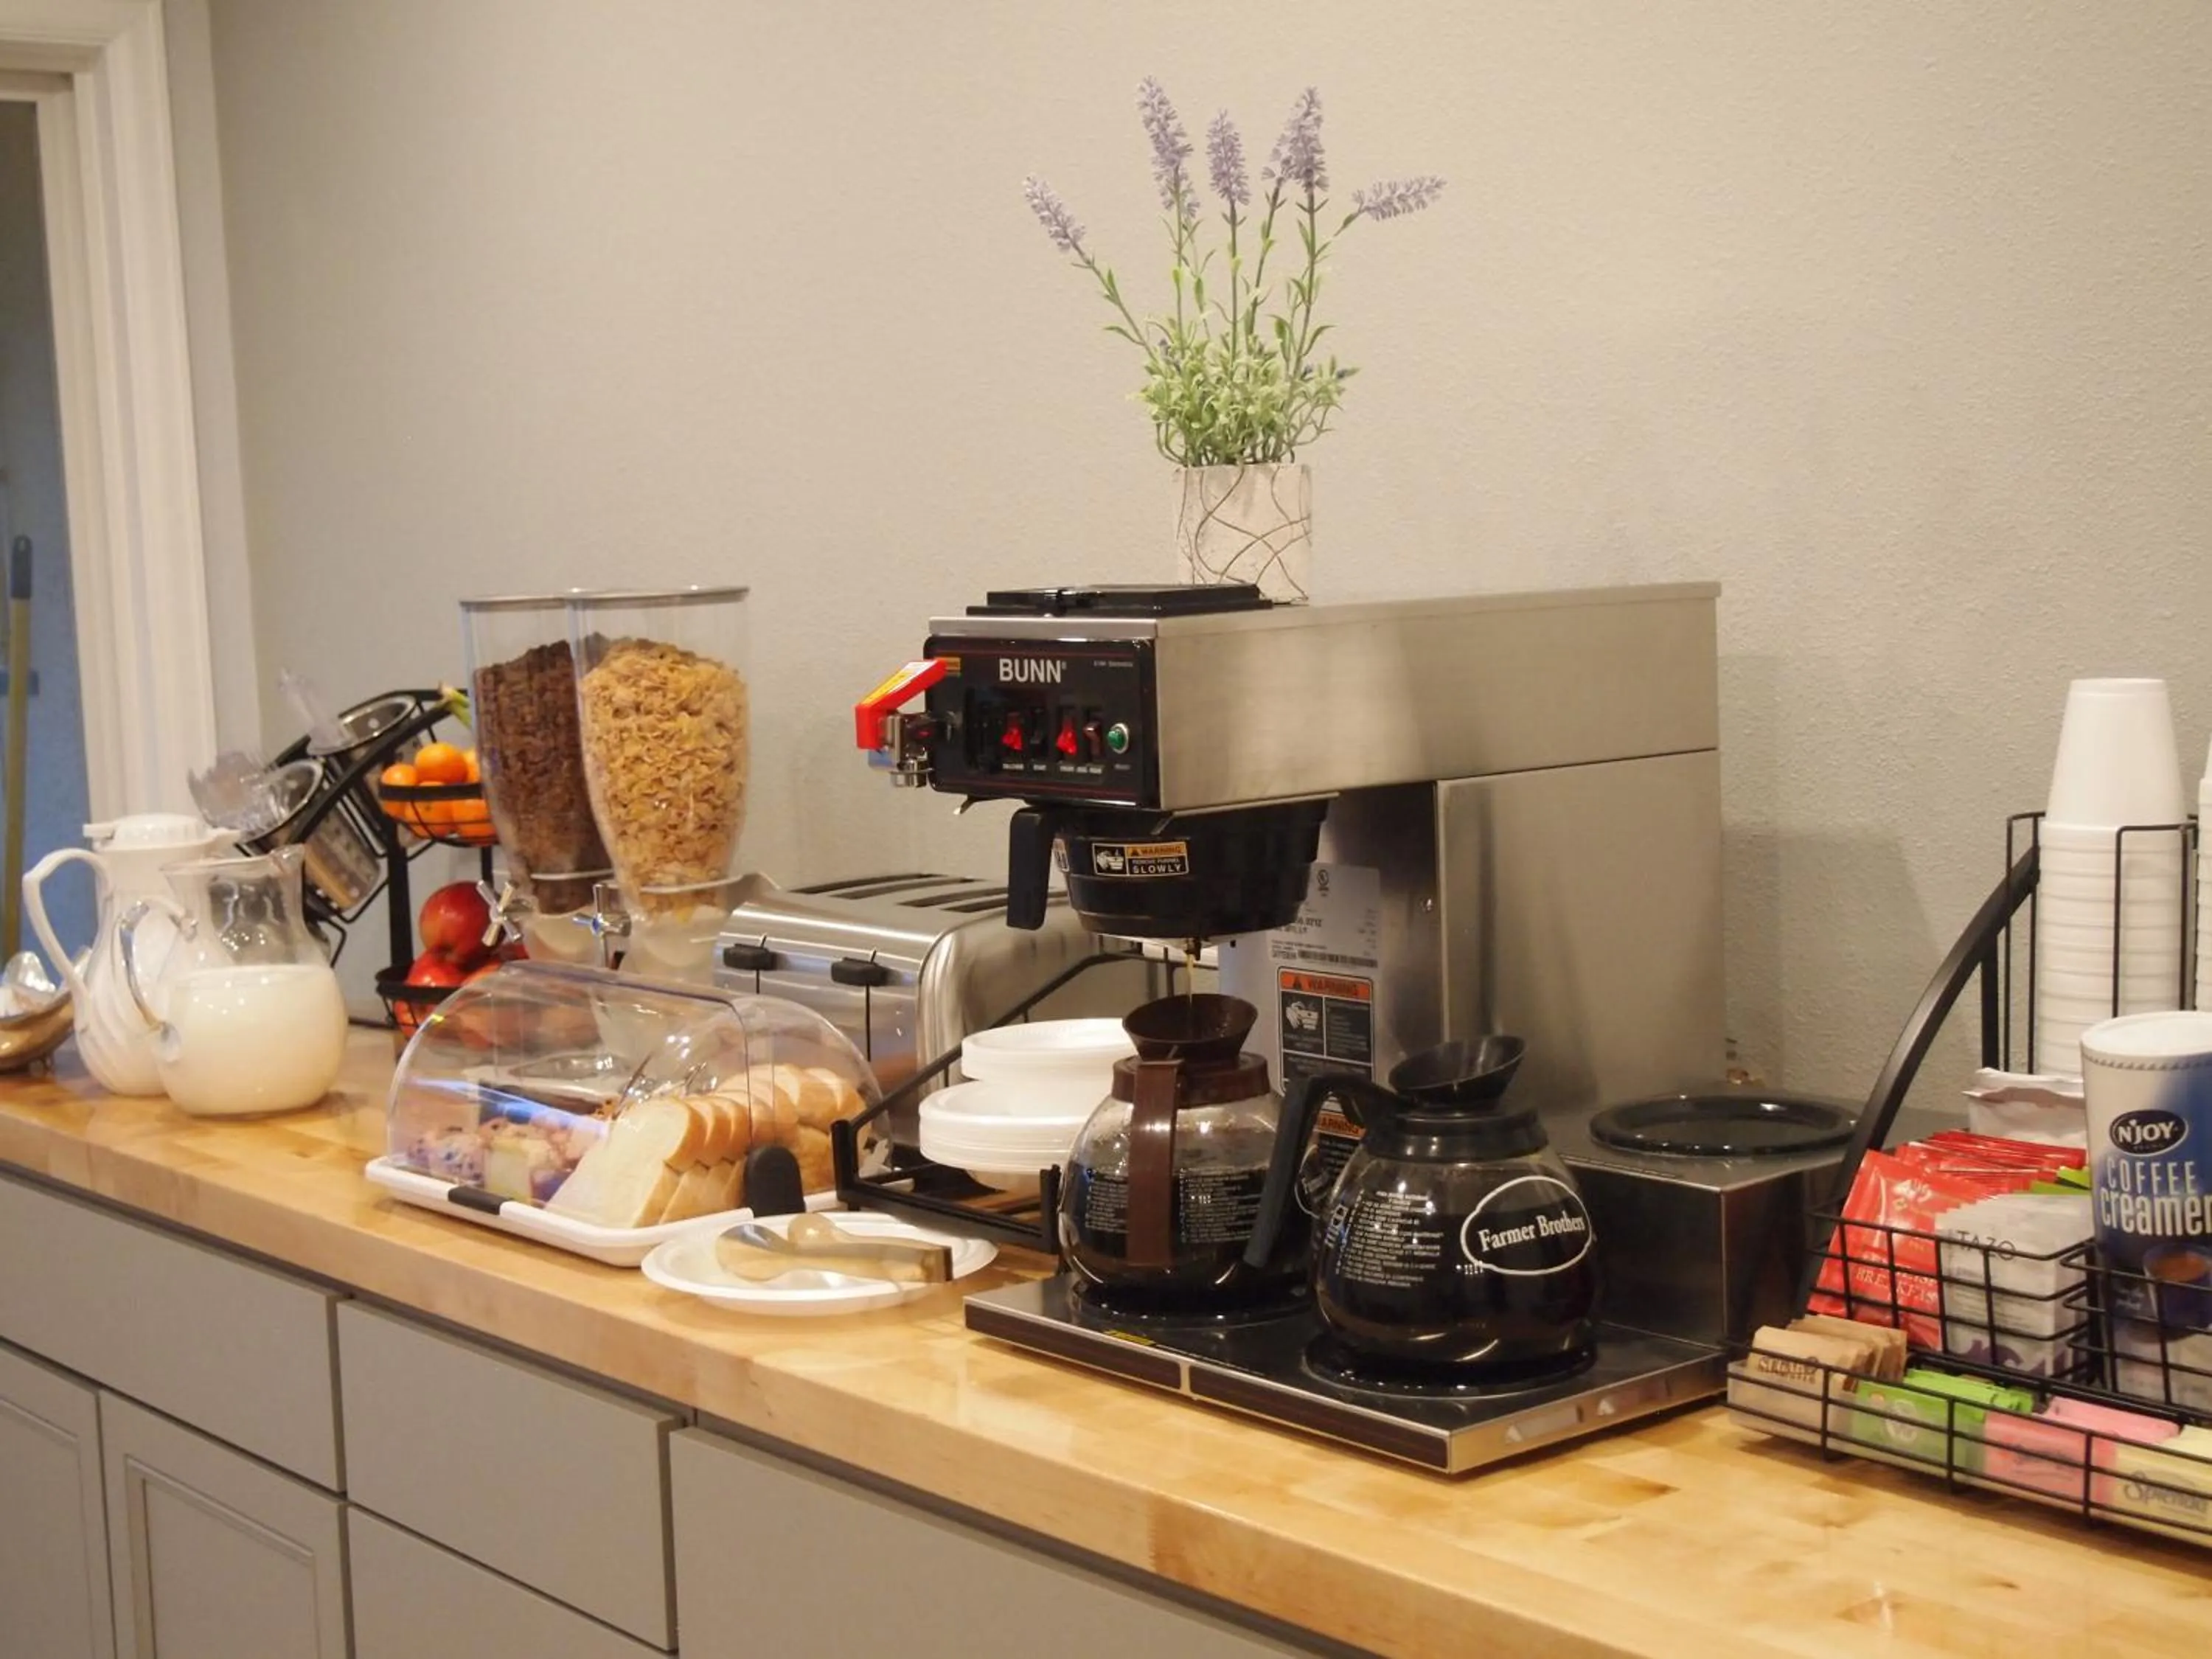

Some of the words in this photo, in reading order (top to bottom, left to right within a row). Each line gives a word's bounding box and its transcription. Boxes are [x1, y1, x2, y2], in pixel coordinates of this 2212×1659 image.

[999, 658, 1061, 684] BUNN
[1133, 863, 1181, 874] SLOWLY
[2107, 1157, 2197, 1196] COFFEE
[1478, 1224, 1536, 1253] Farmer
[1536, 1209, 1585, 1237] Brothers
[1956, 1230, 2016, 1261] TAZO
